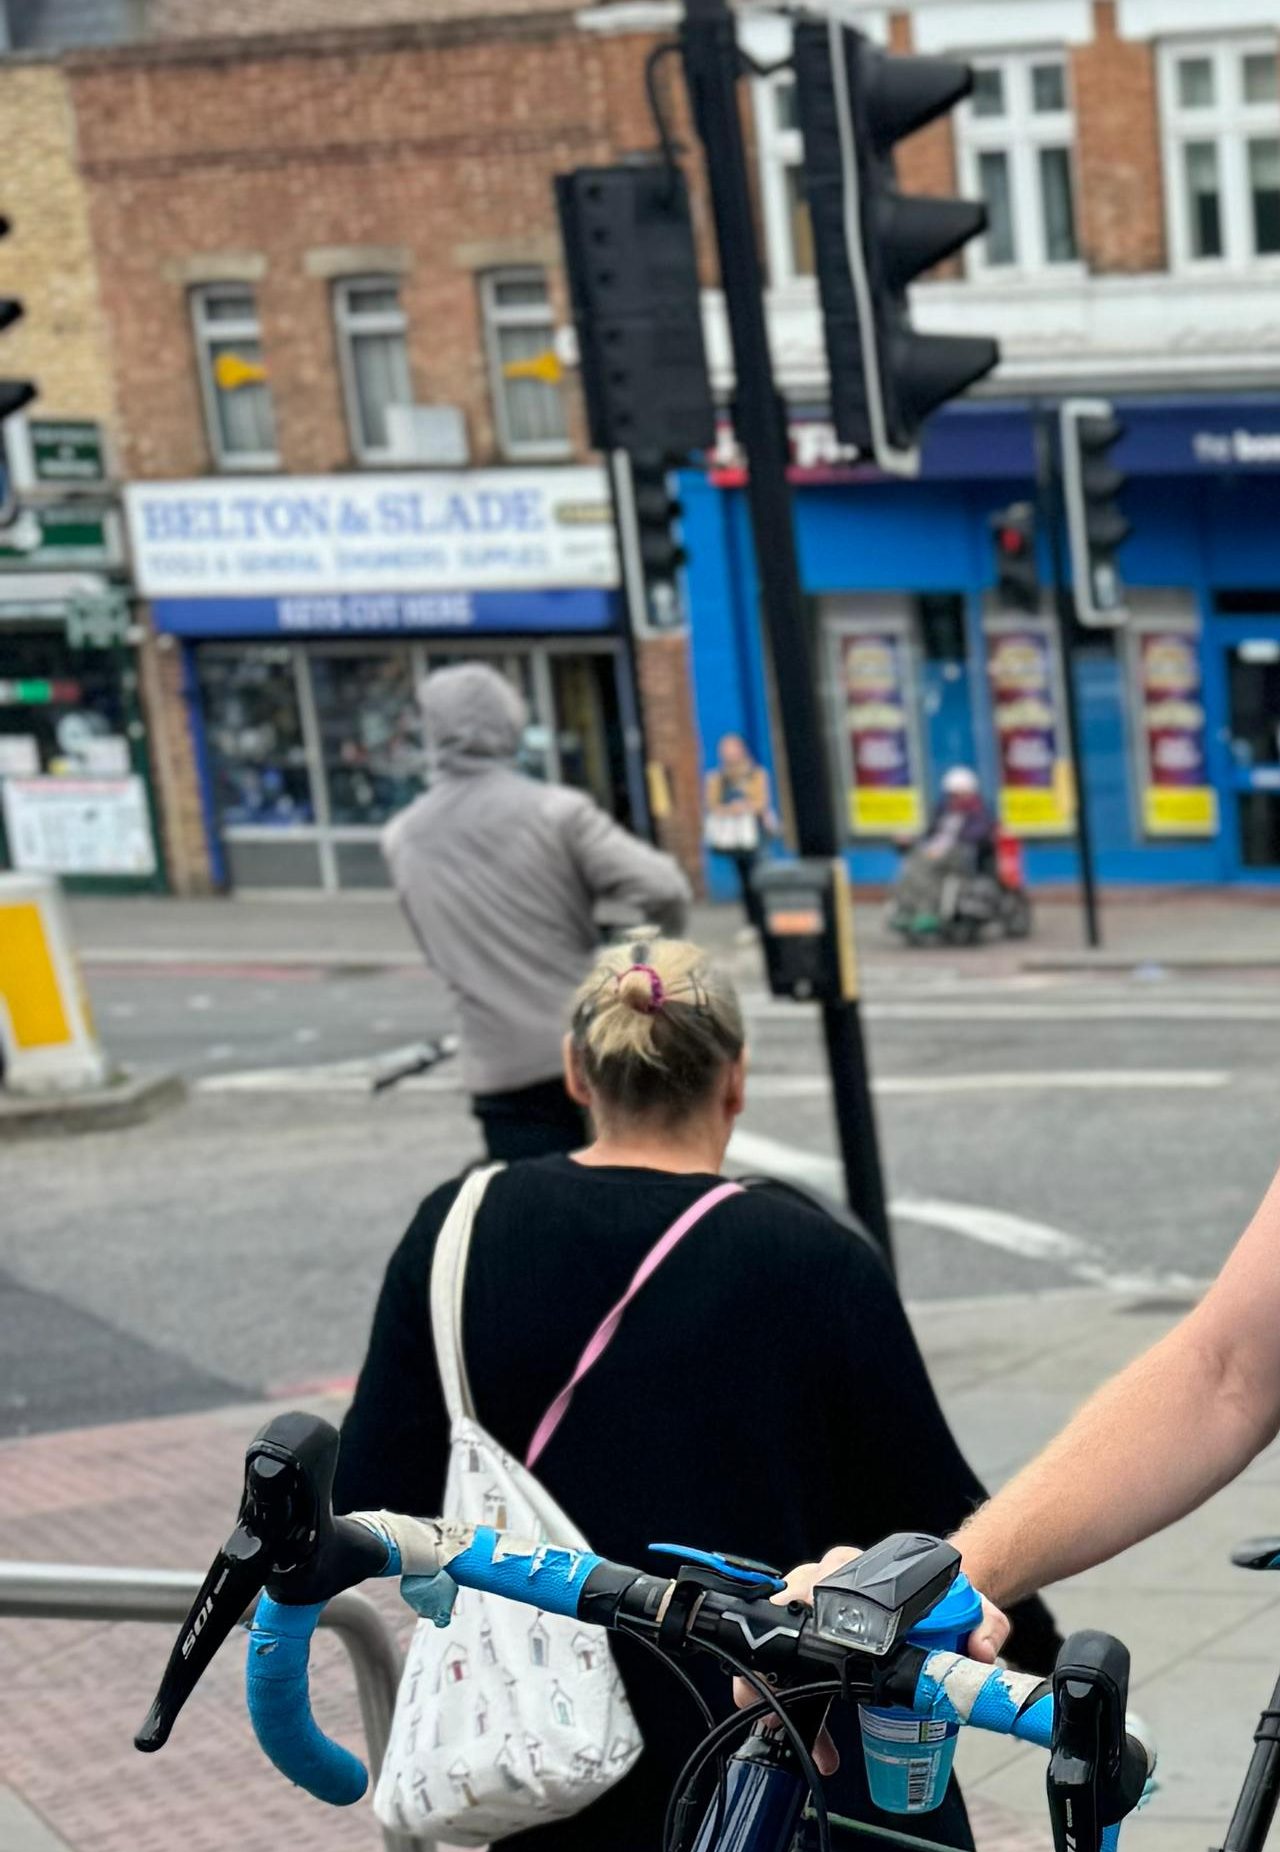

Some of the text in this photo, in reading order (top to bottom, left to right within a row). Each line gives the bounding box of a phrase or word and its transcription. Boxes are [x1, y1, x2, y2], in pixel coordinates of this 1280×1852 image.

[142, 497, 331, 541] BELTON
[338, 496, 370, 536] &
[375, 488, 543, 534] SLADE
[182, 1595, 214, 1661] 105
